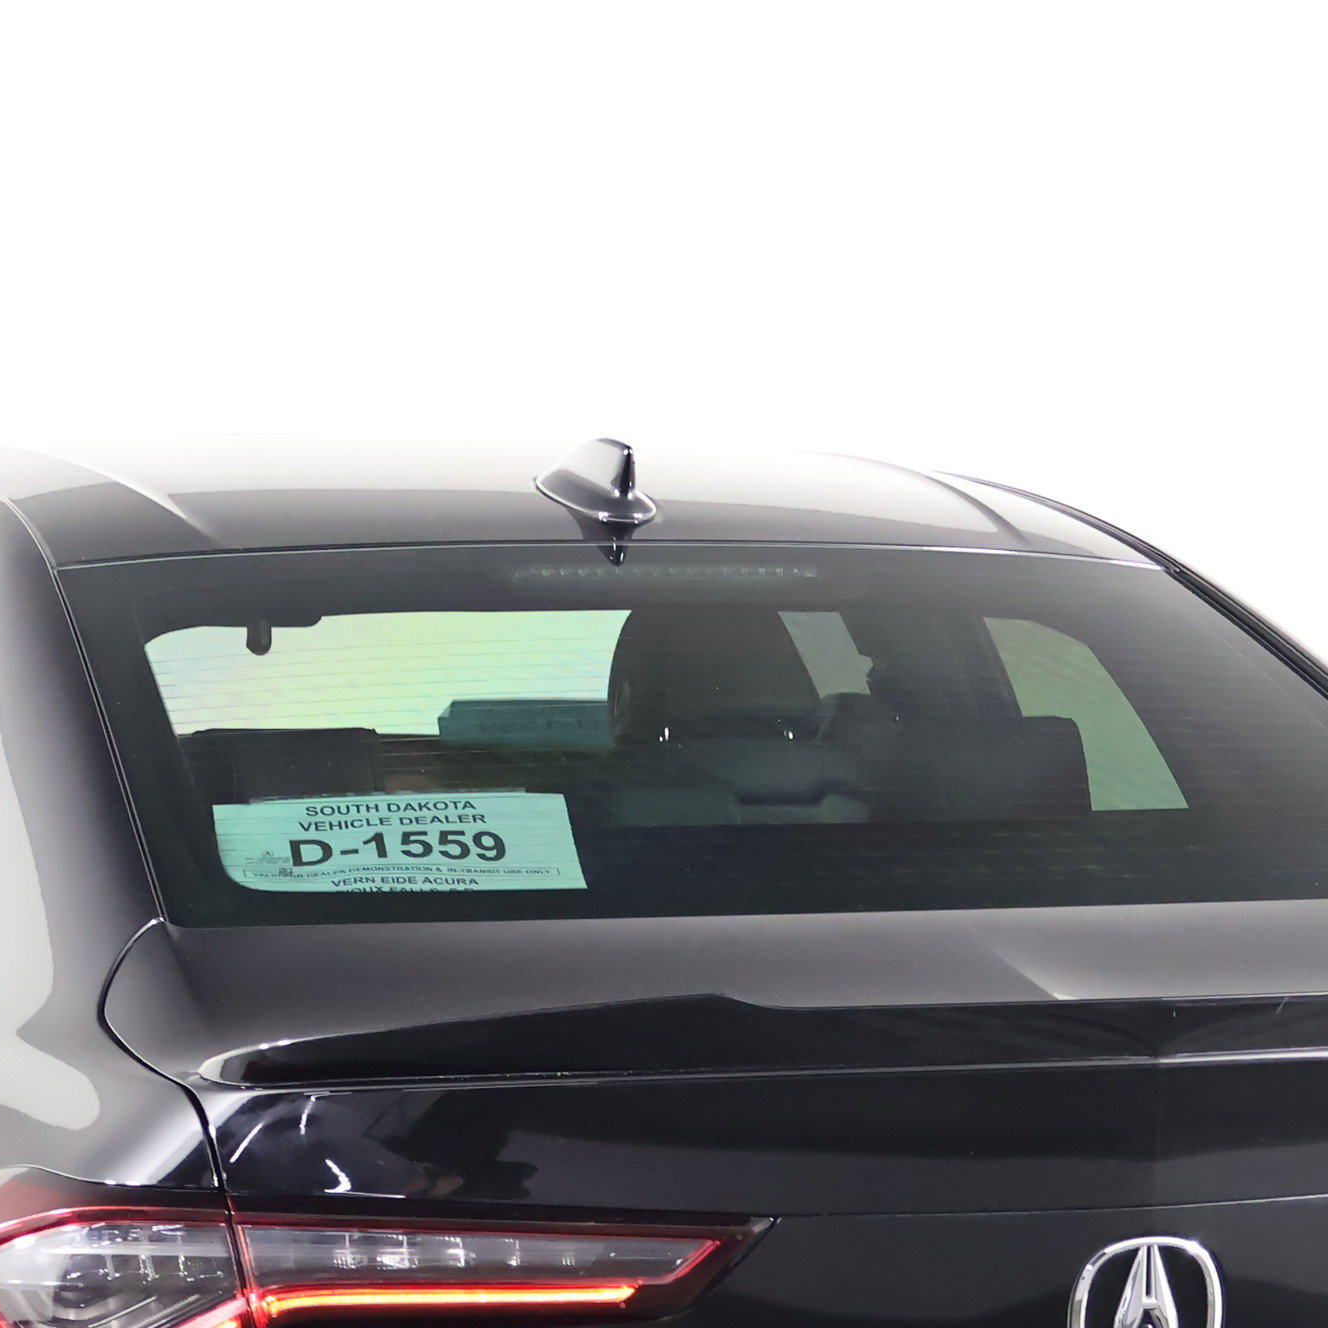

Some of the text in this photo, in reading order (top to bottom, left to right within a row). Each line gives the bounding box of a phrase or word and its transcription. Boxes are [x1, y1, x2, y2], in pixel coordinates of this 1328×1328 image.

[305, 800, 477, 817] SOUTH DAKOTA
[298, 814, 487, 832] VEHICLE DEALER
[288, 830, 506, 867] D-1559
[348, 865, 433, 873] DEMONSTRATION
[331, 876, 479, 888] VERN EIDE ACURA
